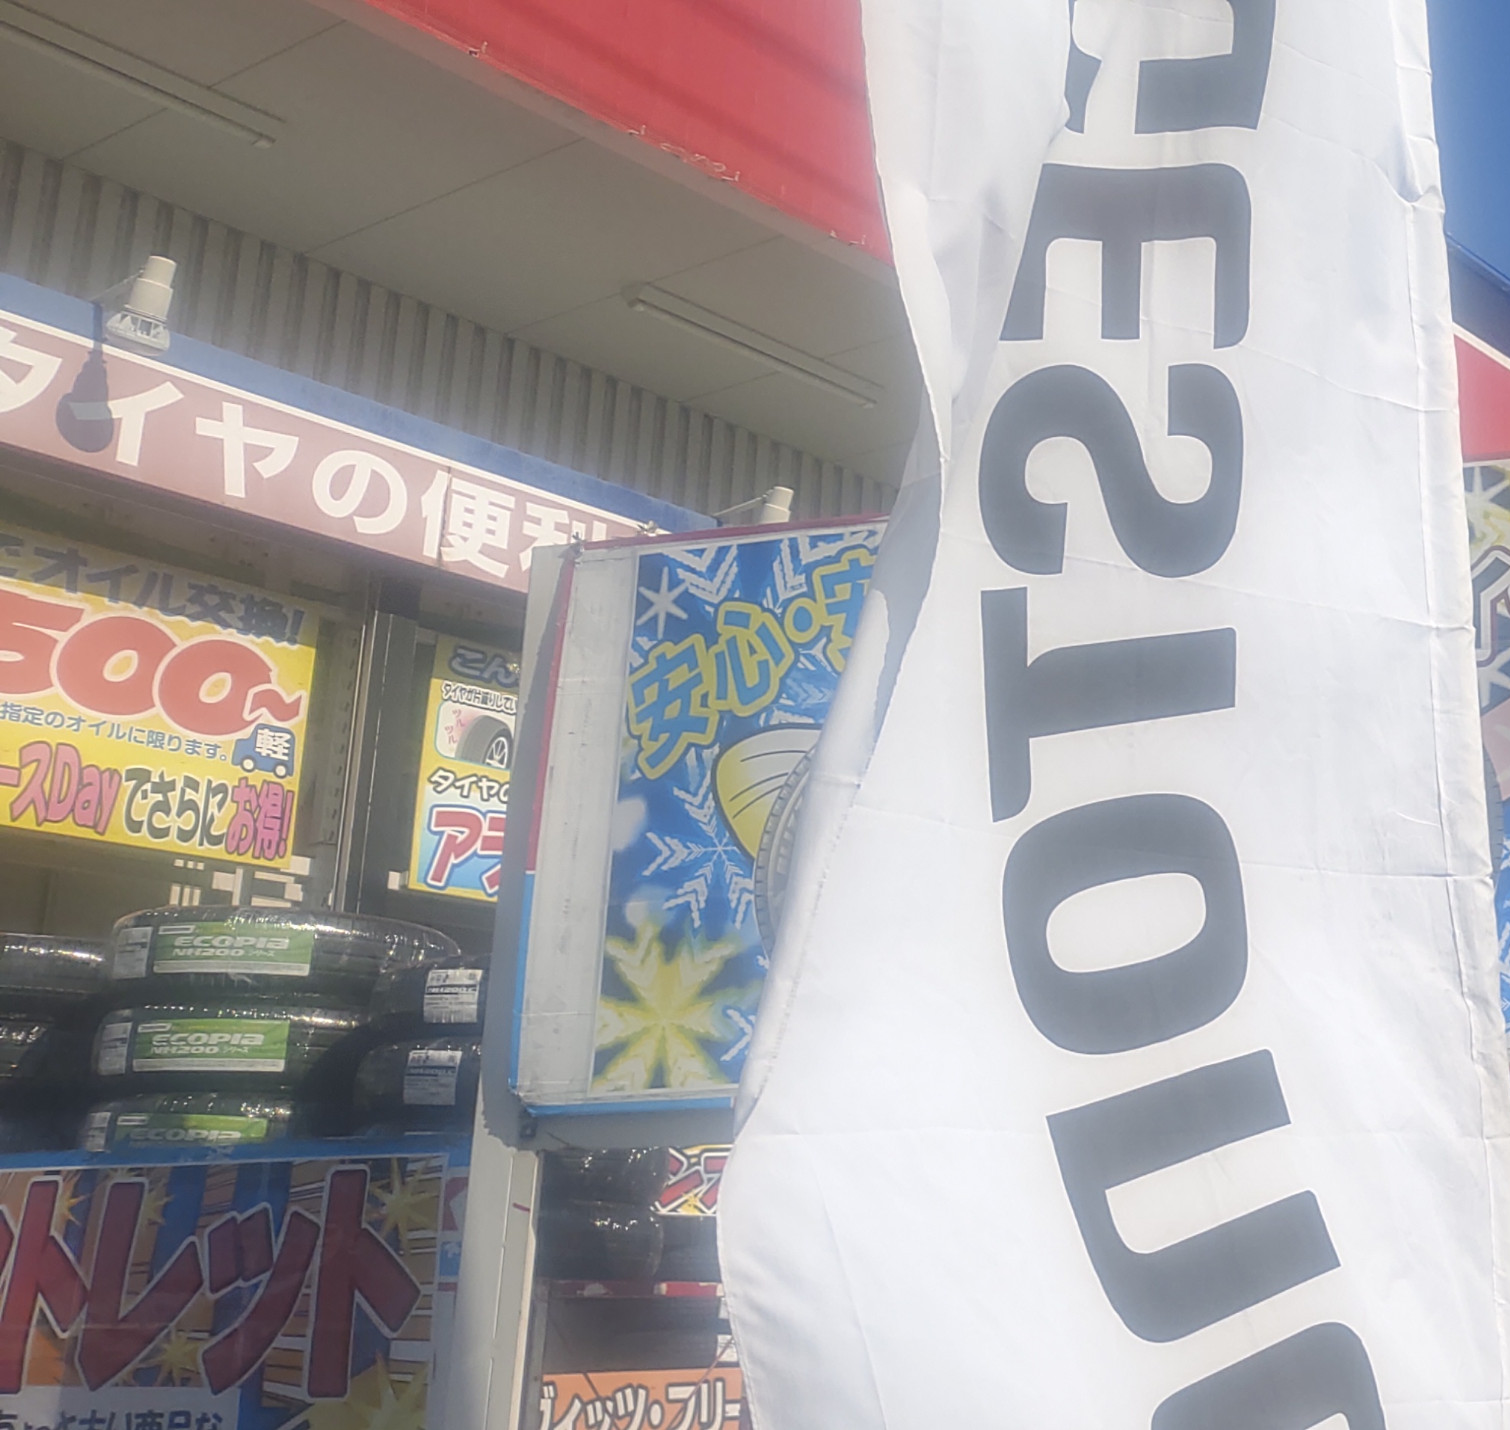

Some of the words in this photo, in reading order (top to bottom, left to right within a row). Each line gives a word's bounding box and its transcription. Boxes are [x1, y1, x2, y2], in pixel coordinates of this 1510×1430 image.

[0, 703, 228, 762] 指定のオイルに限ります。
[254, 727, 291, 762] 軽
[0, 1168, 421, 1399] トレット
